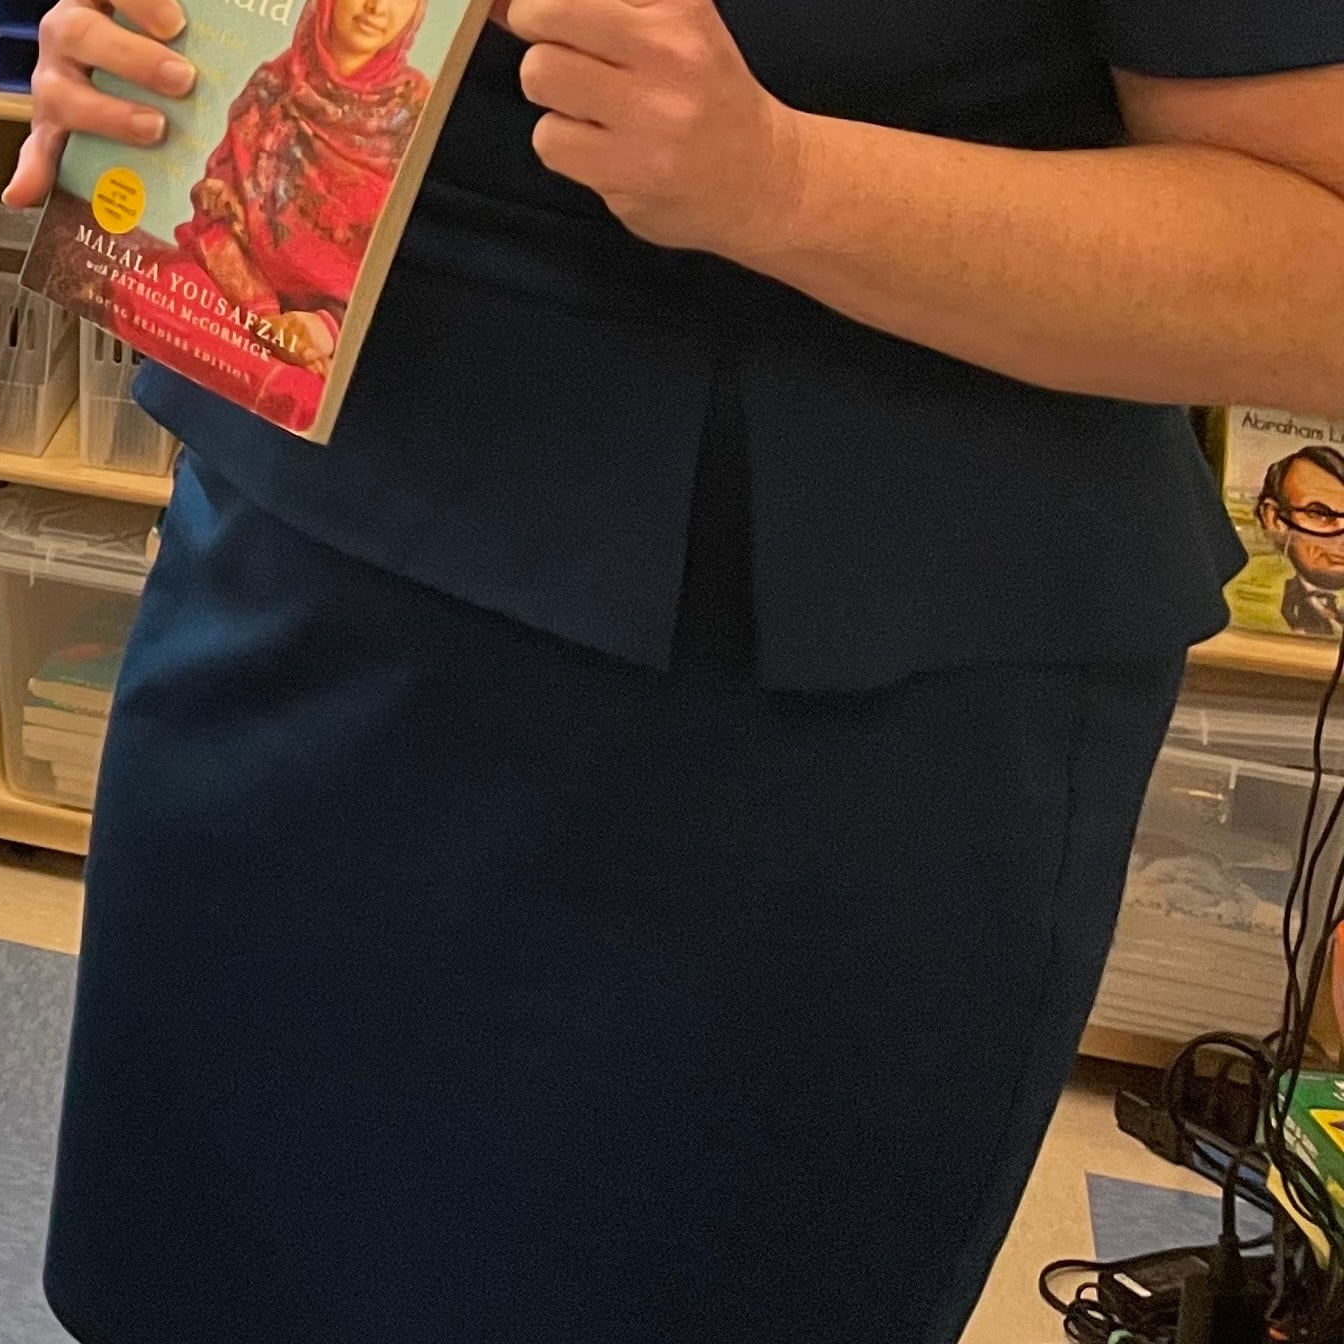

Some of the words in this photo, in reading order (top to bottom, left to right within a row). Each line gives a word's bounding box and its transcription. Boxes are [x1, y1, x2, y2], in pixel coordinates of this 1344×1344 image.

[75, 224, 161, 282] MALALA
[169, 272, 298, 353] YOUSAFZAI
[110, 268, 176, 313] PATRICIA
[133, 315, 190, 353] READERS
[193, 346, 252, 385] EDITION
[1241, 410, 1324, 442] Abraham
